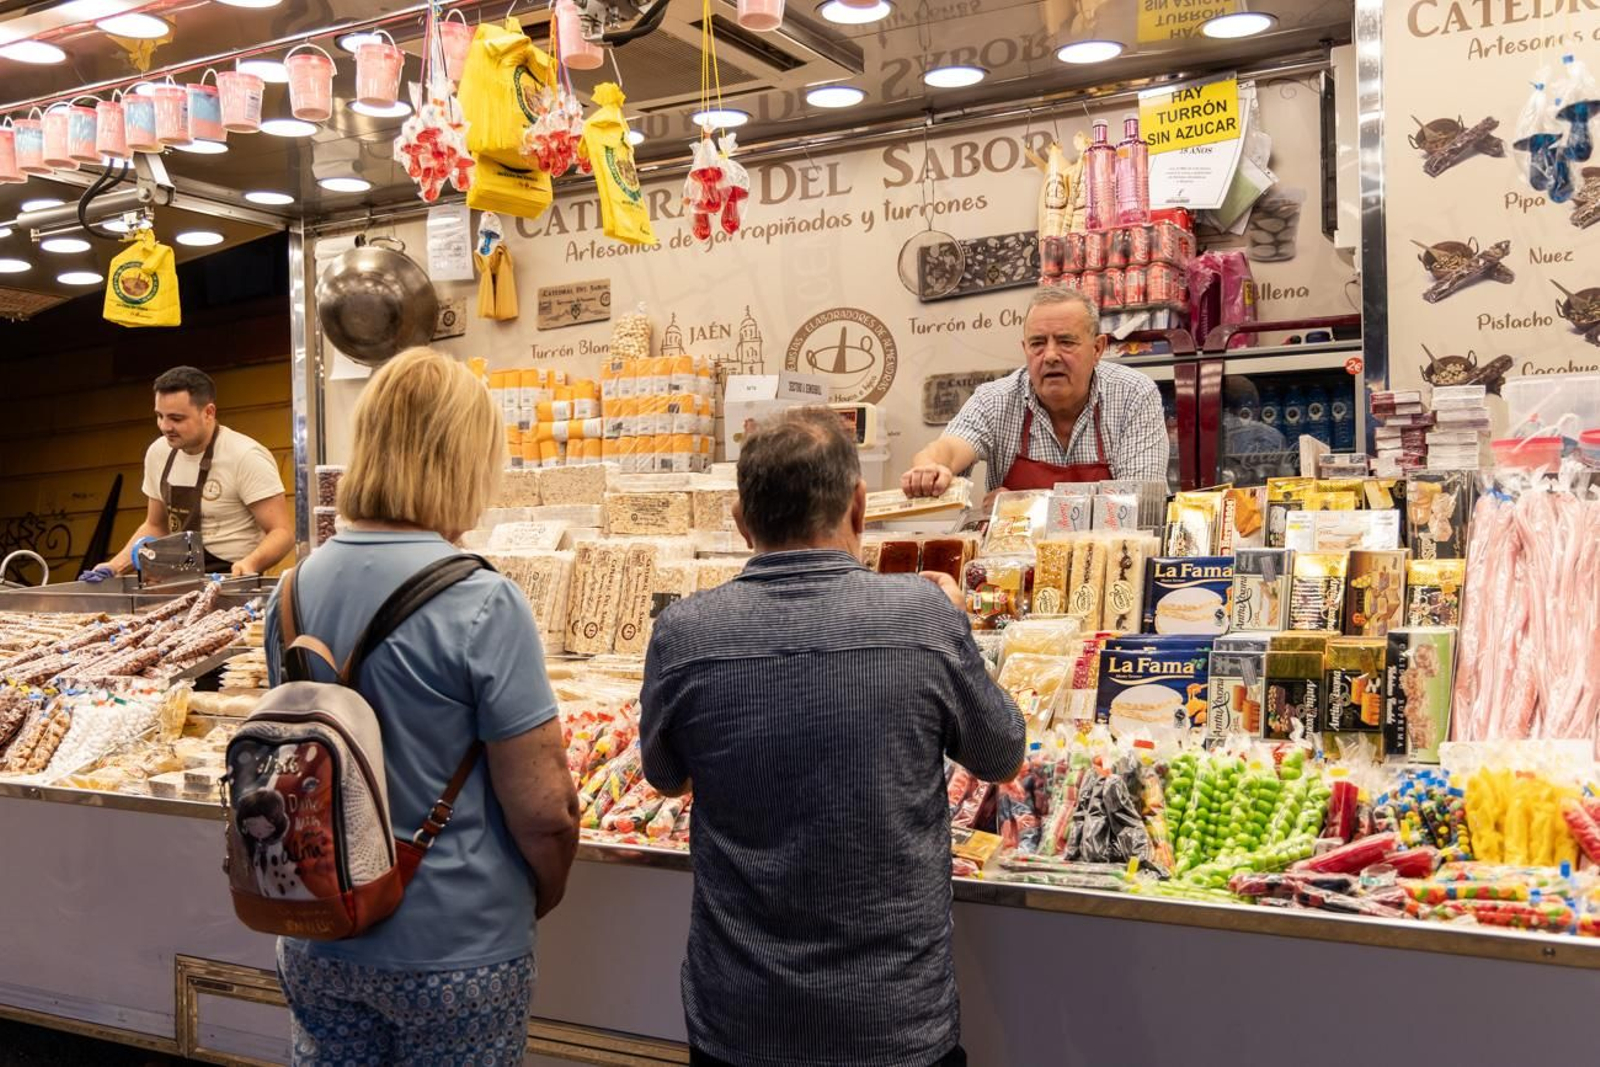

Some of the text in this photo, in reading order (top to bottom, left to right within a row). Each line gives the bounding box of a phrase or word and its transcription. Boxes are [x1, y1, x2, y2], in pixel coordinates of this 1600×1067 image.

[1170, 85, 1205, 104] HAY
[1156, 99, 1228, 126] TURRÓN
[1147, 117, 1237, 147] SIN AZUCAR
[1504, 191, 1546, 213] Pipa
[669, 227, 693, 250] de
[861, 207, 876, 233] y
[883, 191, 988, 222] turrones
[1528, 246, 1574, 265] Nuez
[1256, 282, 1310, 301] llena
[908, 309, 1026, 335] Turrón de Ch
[1476, 310, 1553, 331] Pistacho
[689, 321, 732, 345] JAÉN
[531, 343, 574, 360] Turrón
[1154, 562, 1234, 579] La Fama
[1108, 656, 1195, 674] La Fama
[1396, 698, 1406, 749] SUPREMA
